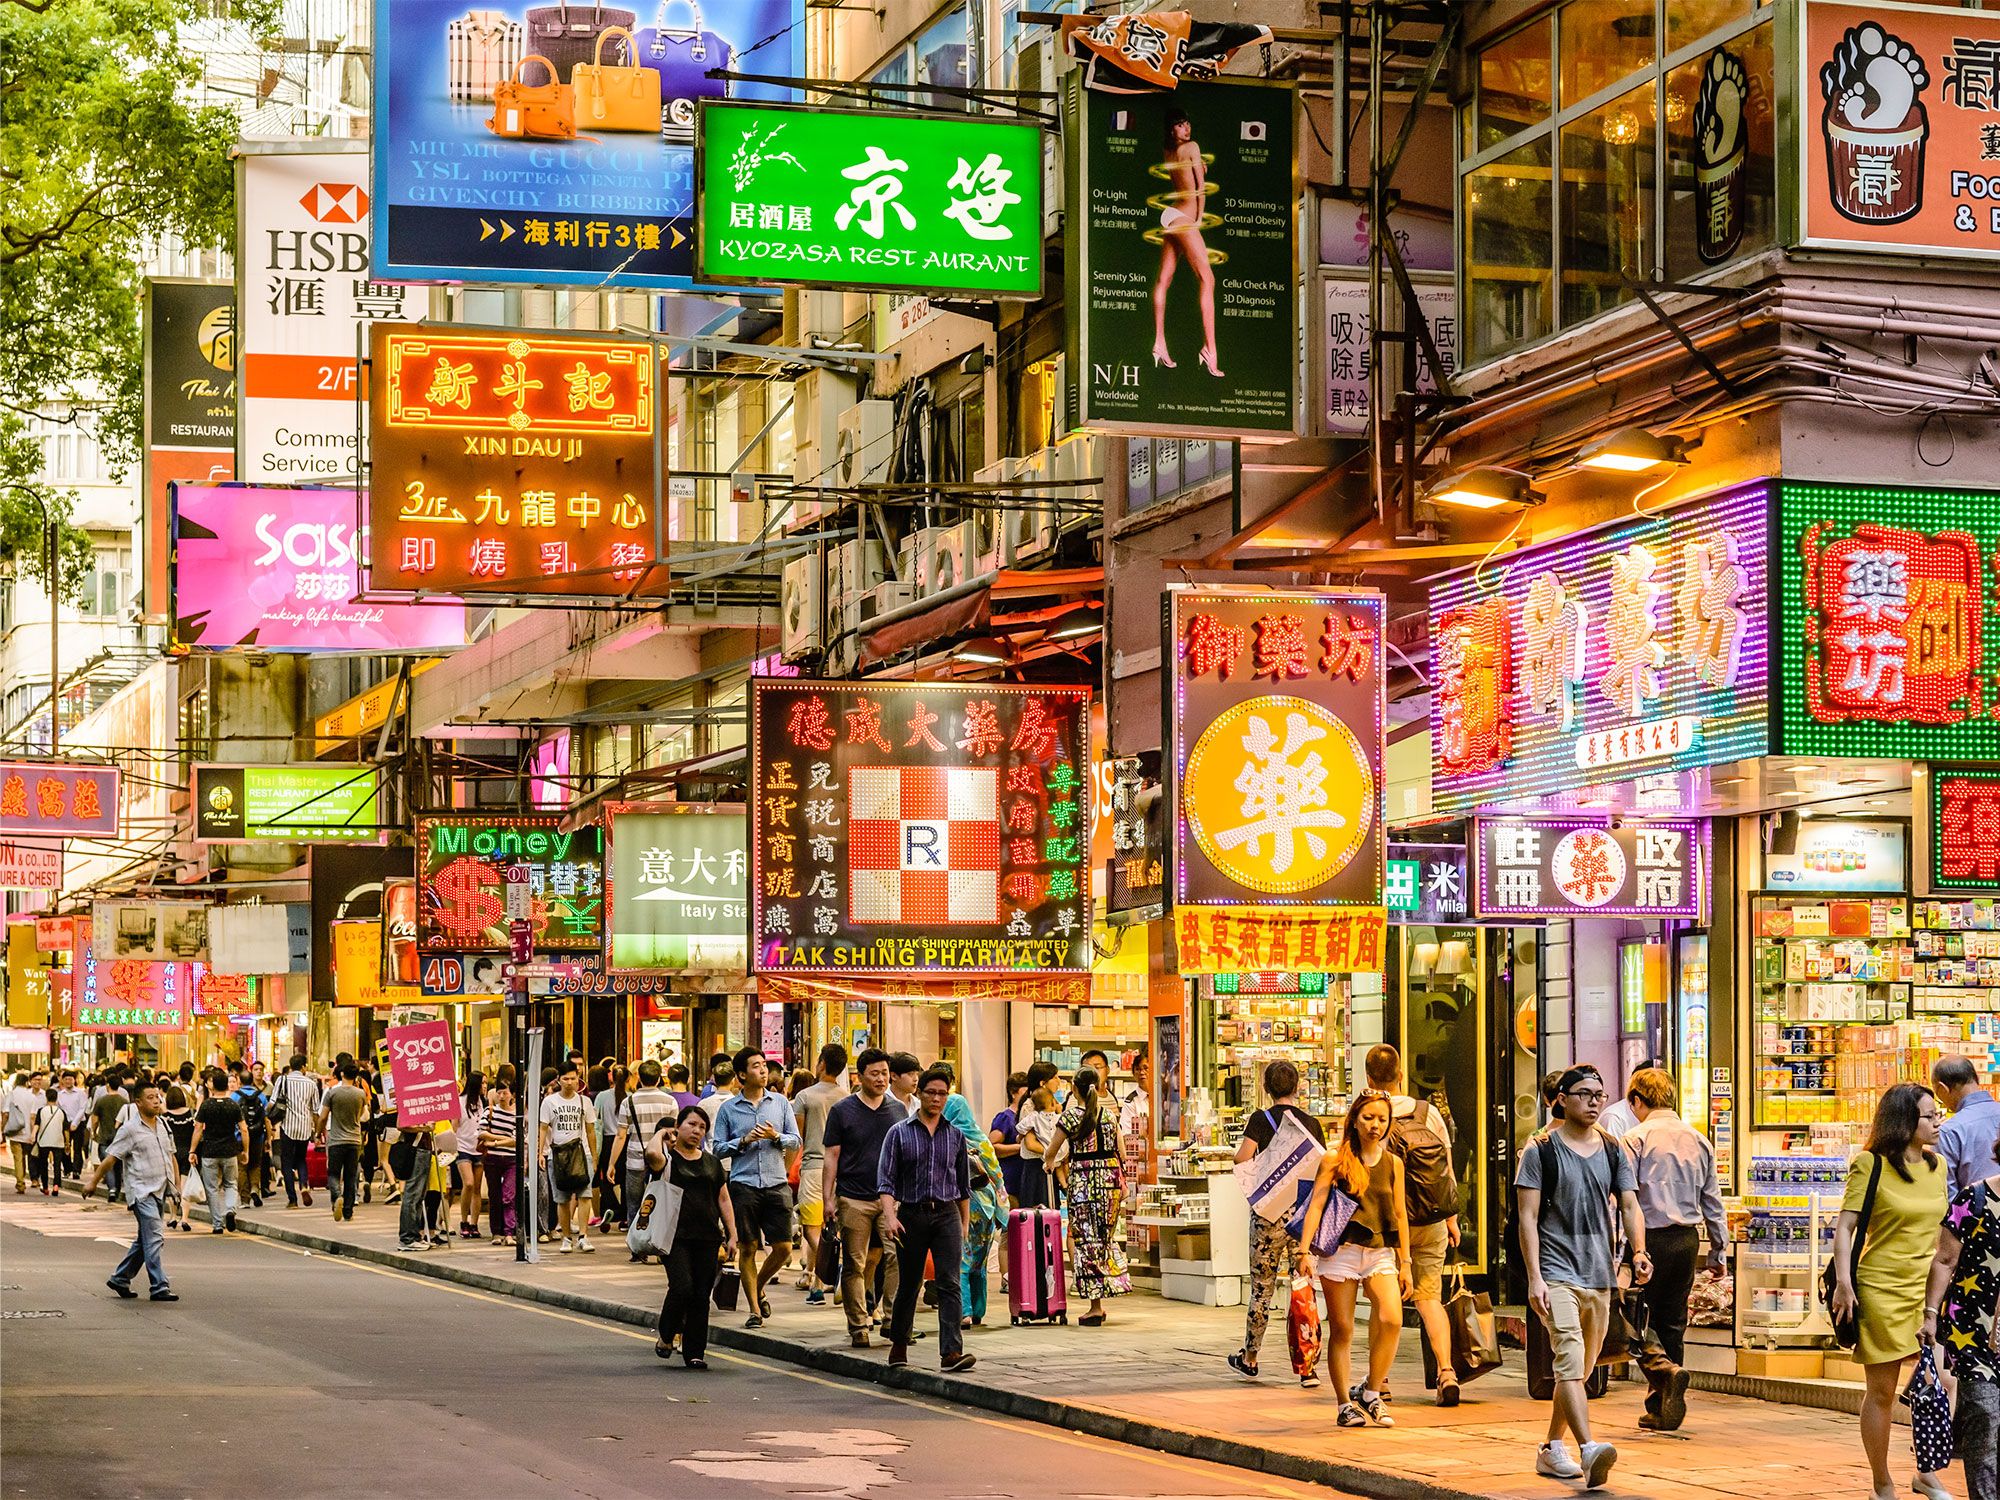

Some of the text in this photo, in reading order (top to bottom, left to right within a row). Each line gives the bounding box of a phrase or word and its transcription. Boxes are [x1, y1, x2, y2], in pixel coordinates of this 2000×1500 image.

[409, 140, 456, 155] MIU
[462, 142, 508, 158] MIU
[528, 148, 649, 172] GUCCI
[412, 161, 470, 180] YSL
[483, 170, 571, 185] BOTTEGA
[579, 174, 652, 188] VENETA
[408, 186, 685, 212] GIVENCHY BURBERRY
[1093, 189, 1128, 201] Or-Light
[1225, 198, 1277, 211] 3D Slimming
[728, 202, 813, 232] 居酒屋
[1093, 205, 1148, 217] Hair Removal
[1224, 214, 1287, 228] Central Obesity
[523, 219, 662, 250] 海利行3樓
[719, 239, 843, 264] KYOZASA
[1093, 271, 1147, 283] Serenity Skin
[1222, 279, 1286, 292] Cellu Check Plus
[1093, 287, 1148, 299] Rejuvenation
[1223, 294, 1276, 307] 3D Diagnosis
[181, 380, 220, 400] Thai
[317, 366, 357, 390] 2/F
[425, 357, 615, 413] 新斗記
[1095, 390, 1139, 401] Worldwide
[464, 436, 582, 461] XIN DAU JI
[262, 453, 338, 472] Service
[400, 481, 447, 517] 3/F
[474, 488, 647, 529] 九龍中心
[400, 537, 647, 580] 即燒乳豬
[295, 572, 350, 601] 莎莎
[262, 609, 383, 629] making life beautiful
[1837, 549, 1908, 703] 藥坊
[1905, 577, 1969, 679] 御
[1188, 612, 1377, 682] 御藥坊
[786, 696, 1058, 757] 德成大藥房
[249, 789, 310, 797] RESTAURANT
[334, 790, 352, 798] BAR
[250, 776, 271, 787] Thai
[279, 776, 318, 787] Master
[1213, 712, 1347, 876] 藥
[765, 761, 801, 899] 正貨商號
[804, 760, 841, 899] 免稅商店
[1046, 763, 1080, 900] 專業配藥
[436, 827, 573, 860] Money
[20, 871, 25, 885] &
[28, 872, 57, 886] CHEST
[1427, 861, 1460, 898] 米
[1494, 827, 1542, 907] 註冊
[1562, 834, 1617, 902] 藥
[1635, 828, 1682, 907] 政府
[681, 904, 717, 920] Italy
[875, 938, 896, 949] O/B
[897, 939, 920, 949] TAK
[1023, 940, 1069, 950] LIMITED
[1180, 909, 1383, 971] 蟲草燕窩直銷商
[561, 955, 599, 969] Hotel
[776, 947, 1069, 966] TAK SHING PHARMACY
[424, 958, 462, 993] 4D
[552, 972, 668, 993] 3599 8899
[359, 986, 418, 998] Welcome
[406, 1058, 435, 1075] 莎莎
[1714, 1084, 1731, 1093] VISA
[557, 1123, 581, 1131] BALLER
[559, 1114, 579, 1122] BORN
